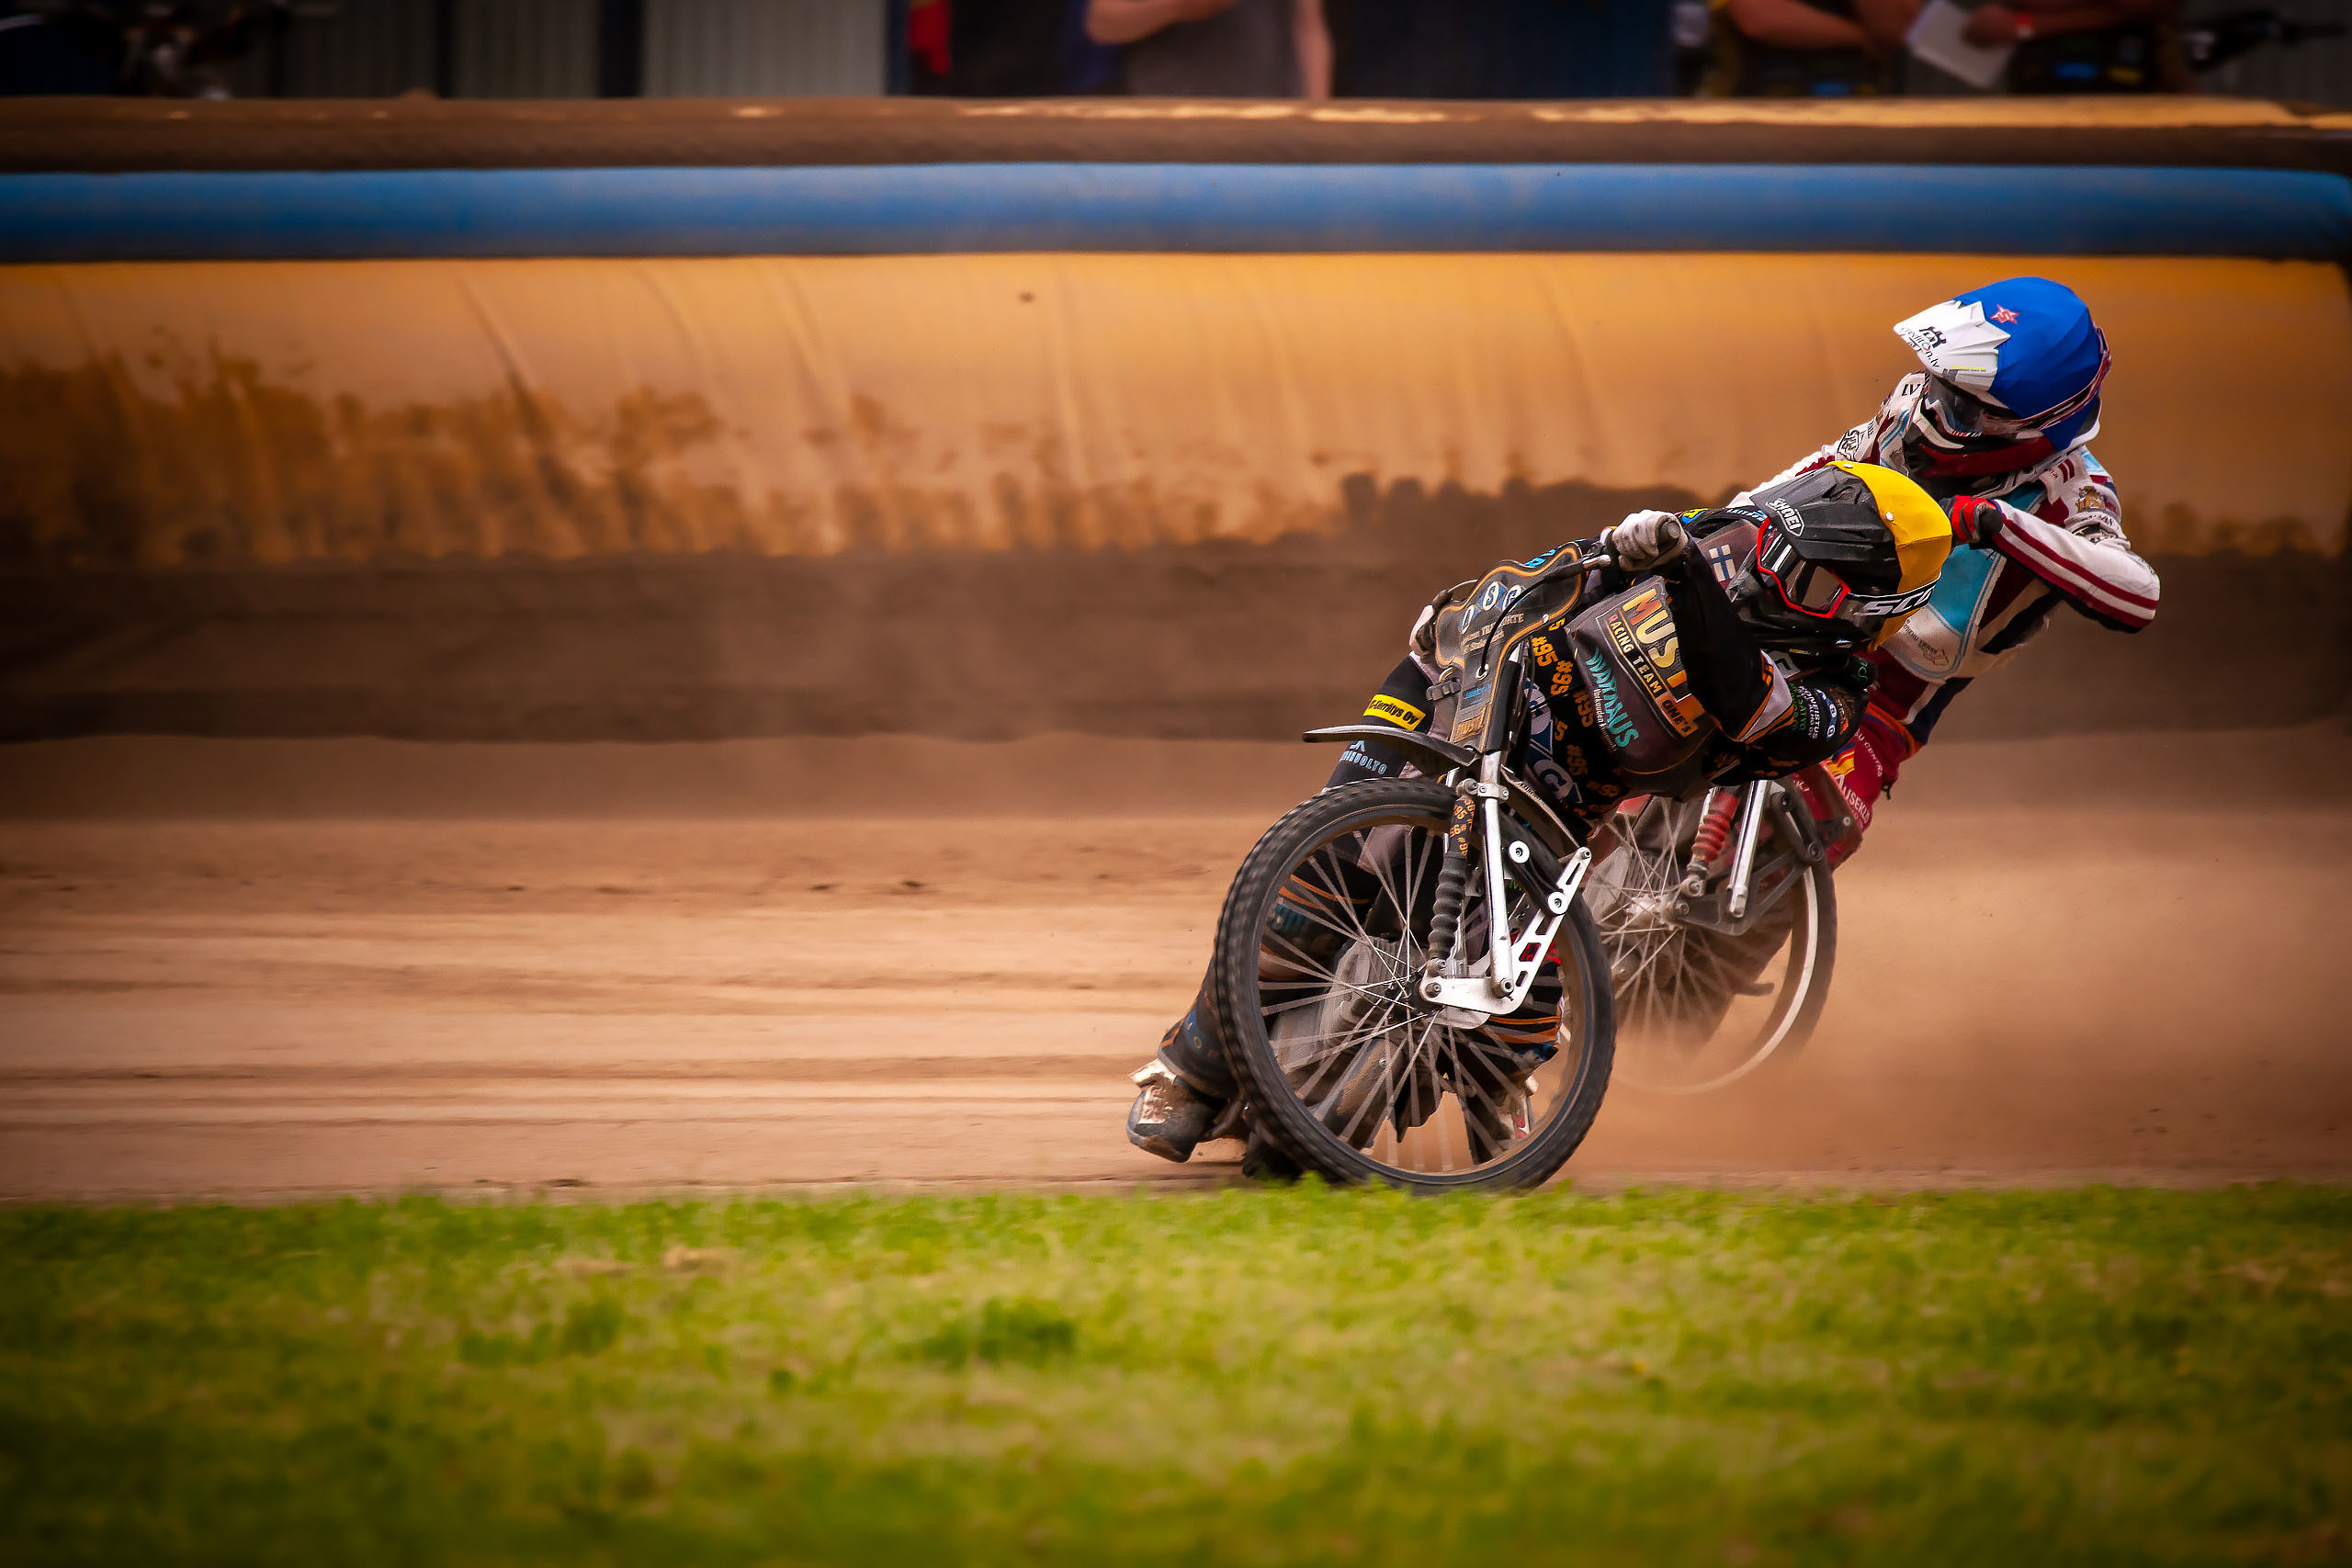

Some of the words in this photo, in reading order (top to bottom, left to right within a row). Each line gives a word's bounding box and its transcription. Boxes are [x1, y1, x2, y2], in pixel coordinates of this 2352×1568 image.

[1771, 499, 1802, 530] SHOEI
[1532, 636, 1558, 667] #95
[1609, 614, 1634, 654] RACING
[1633, 655, 1663, 694] TEAM
[1550, 660, 1574, 695] #95
[1403, 711, 1419, 725] Oy
